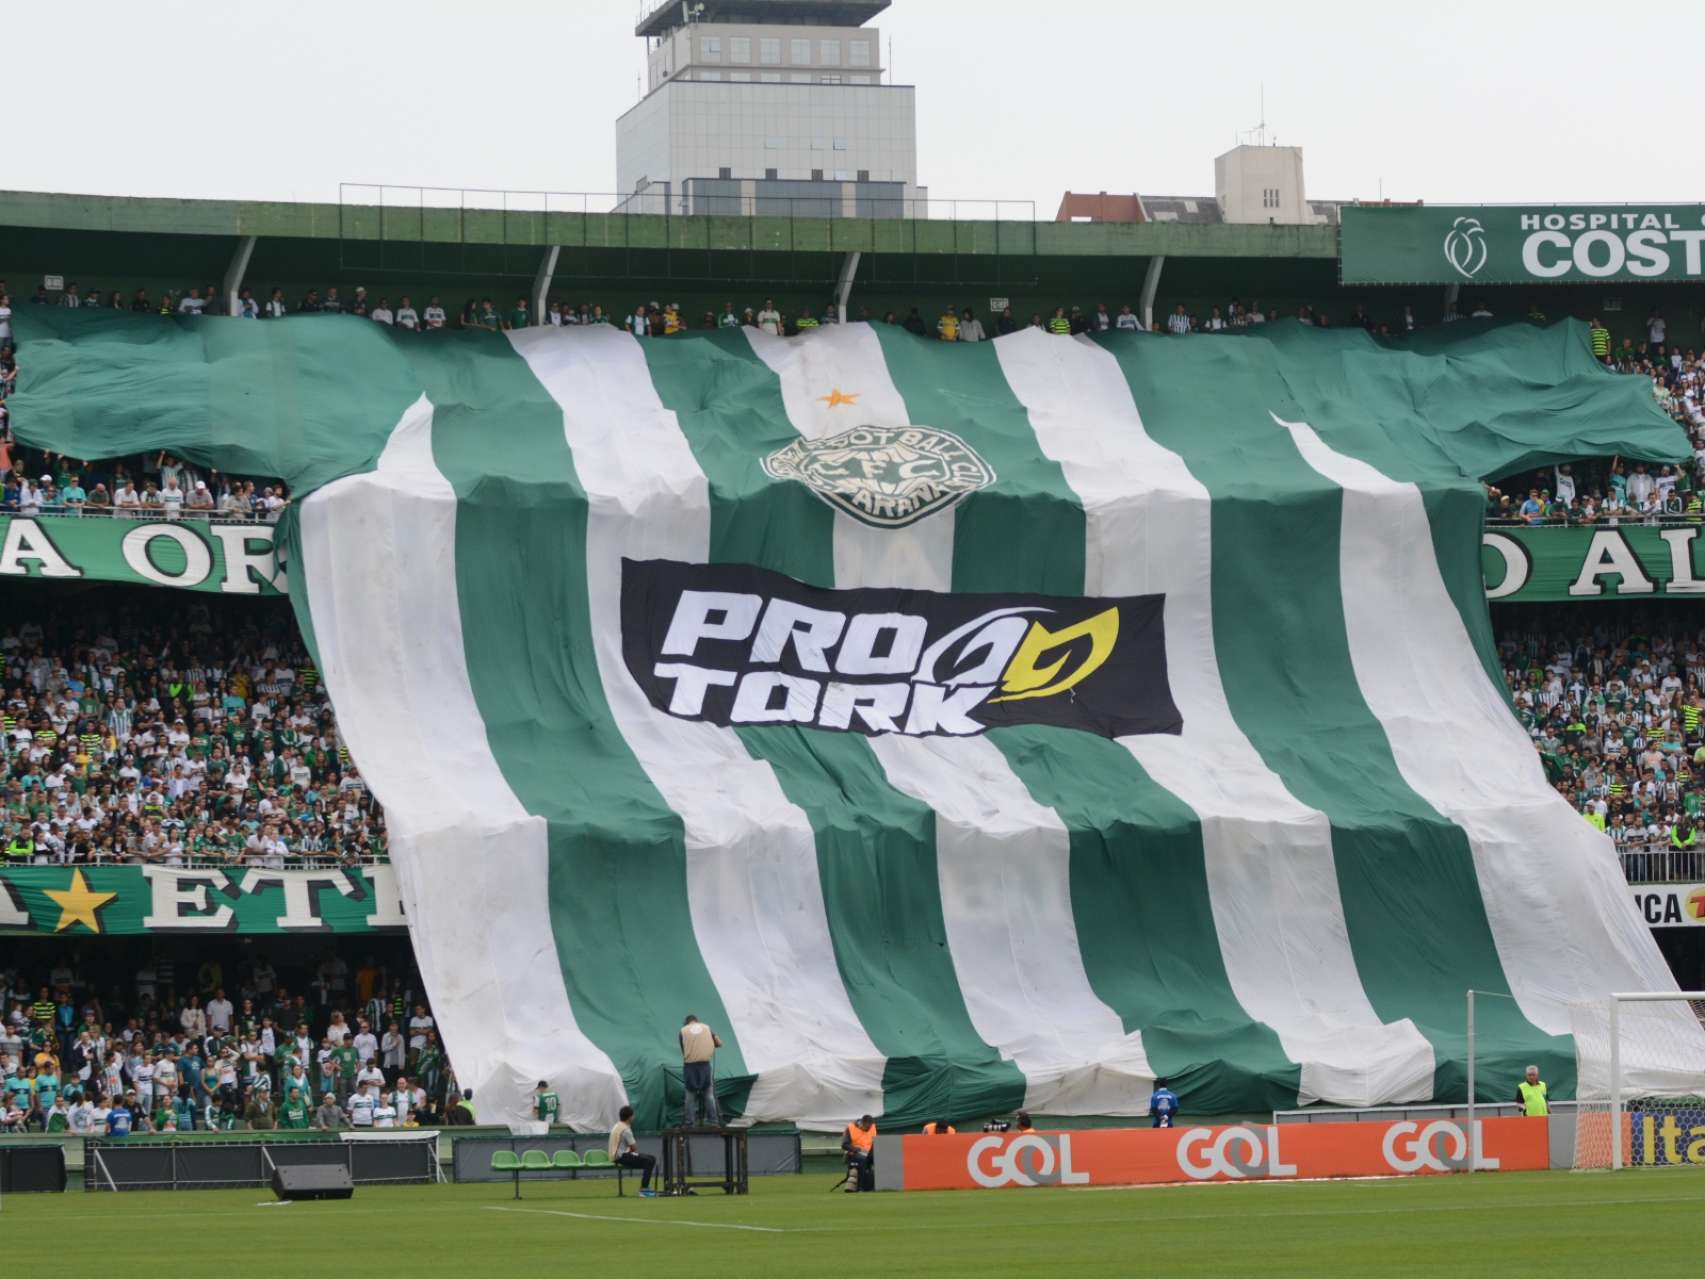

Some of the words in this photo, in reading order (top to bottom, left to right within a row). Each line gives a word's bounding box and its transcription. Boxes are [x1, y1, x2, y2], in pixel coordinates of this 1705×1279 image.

[1520, 213, 1680, 230] HOSPITAL
[1521, 229, 1705, 277] COST
[0, 518, 81, 577] A
[660, 589, 928, 675] PRO
[653, 662, 997, 734] TORK
[545, 1097, 557, 1111] 10
[966, 1133, 1090, 1188] GOL
[1176, 1125, 1298, 1180] GOL
[1382, 1119, 1500, 1173] GOL
